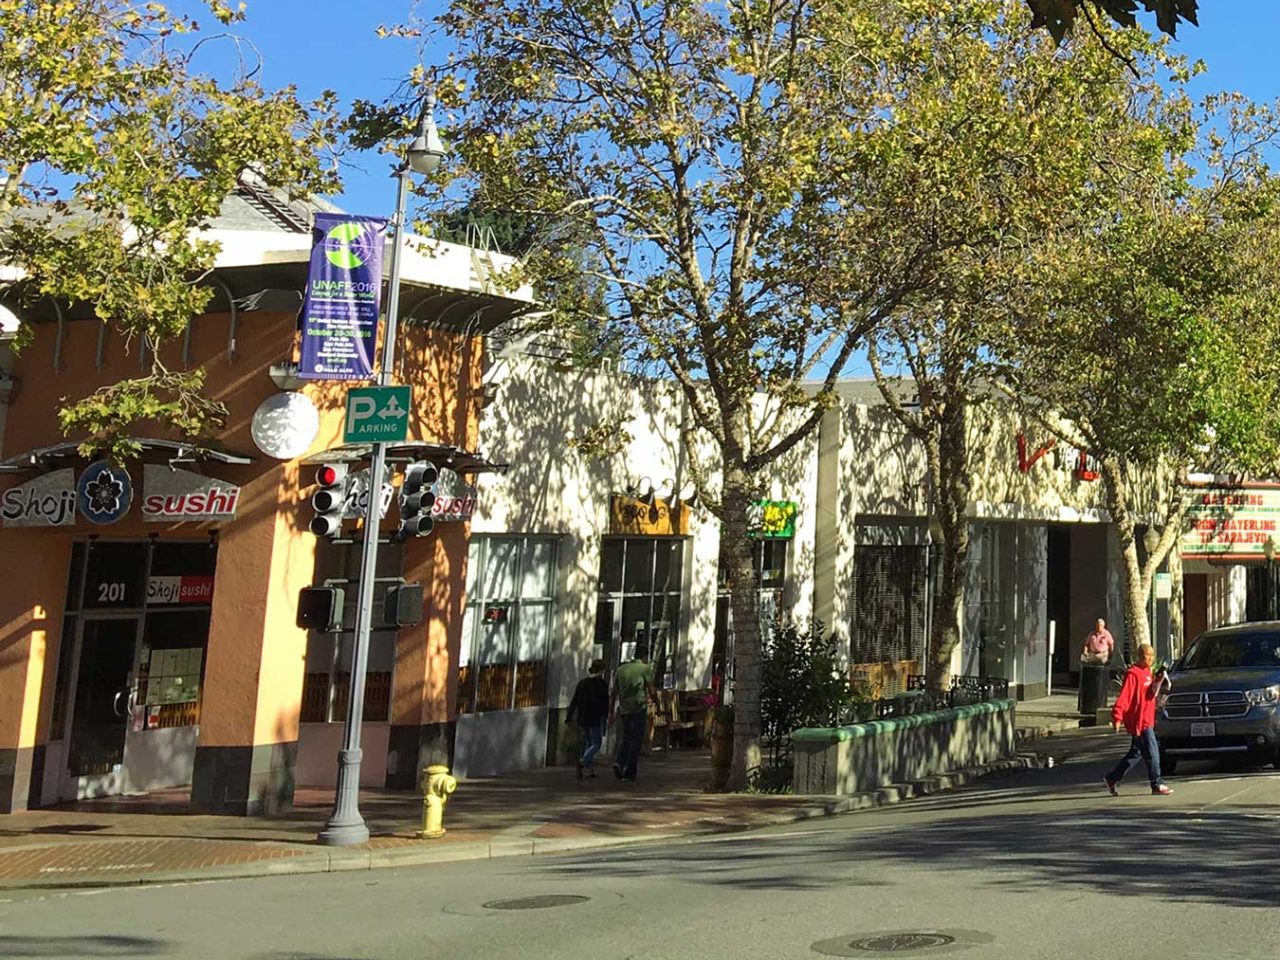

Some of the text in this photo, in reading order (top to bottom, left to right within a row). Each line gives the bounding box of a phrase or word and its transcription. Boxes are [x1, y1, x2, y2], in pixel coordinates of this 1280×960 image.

[312, 280, 377, 292] UNAFF2016
[1, 486, 241, 526] Shoji sushi
[432, 494, 477, 515] sushi
[1222, 519, 1277, 531] MAYERLING
[1216, 531, 1268, 544] SARAJEVO
[97, 583, 126, 602] 201
[147, 580, 212, 603] Shoji sushi
